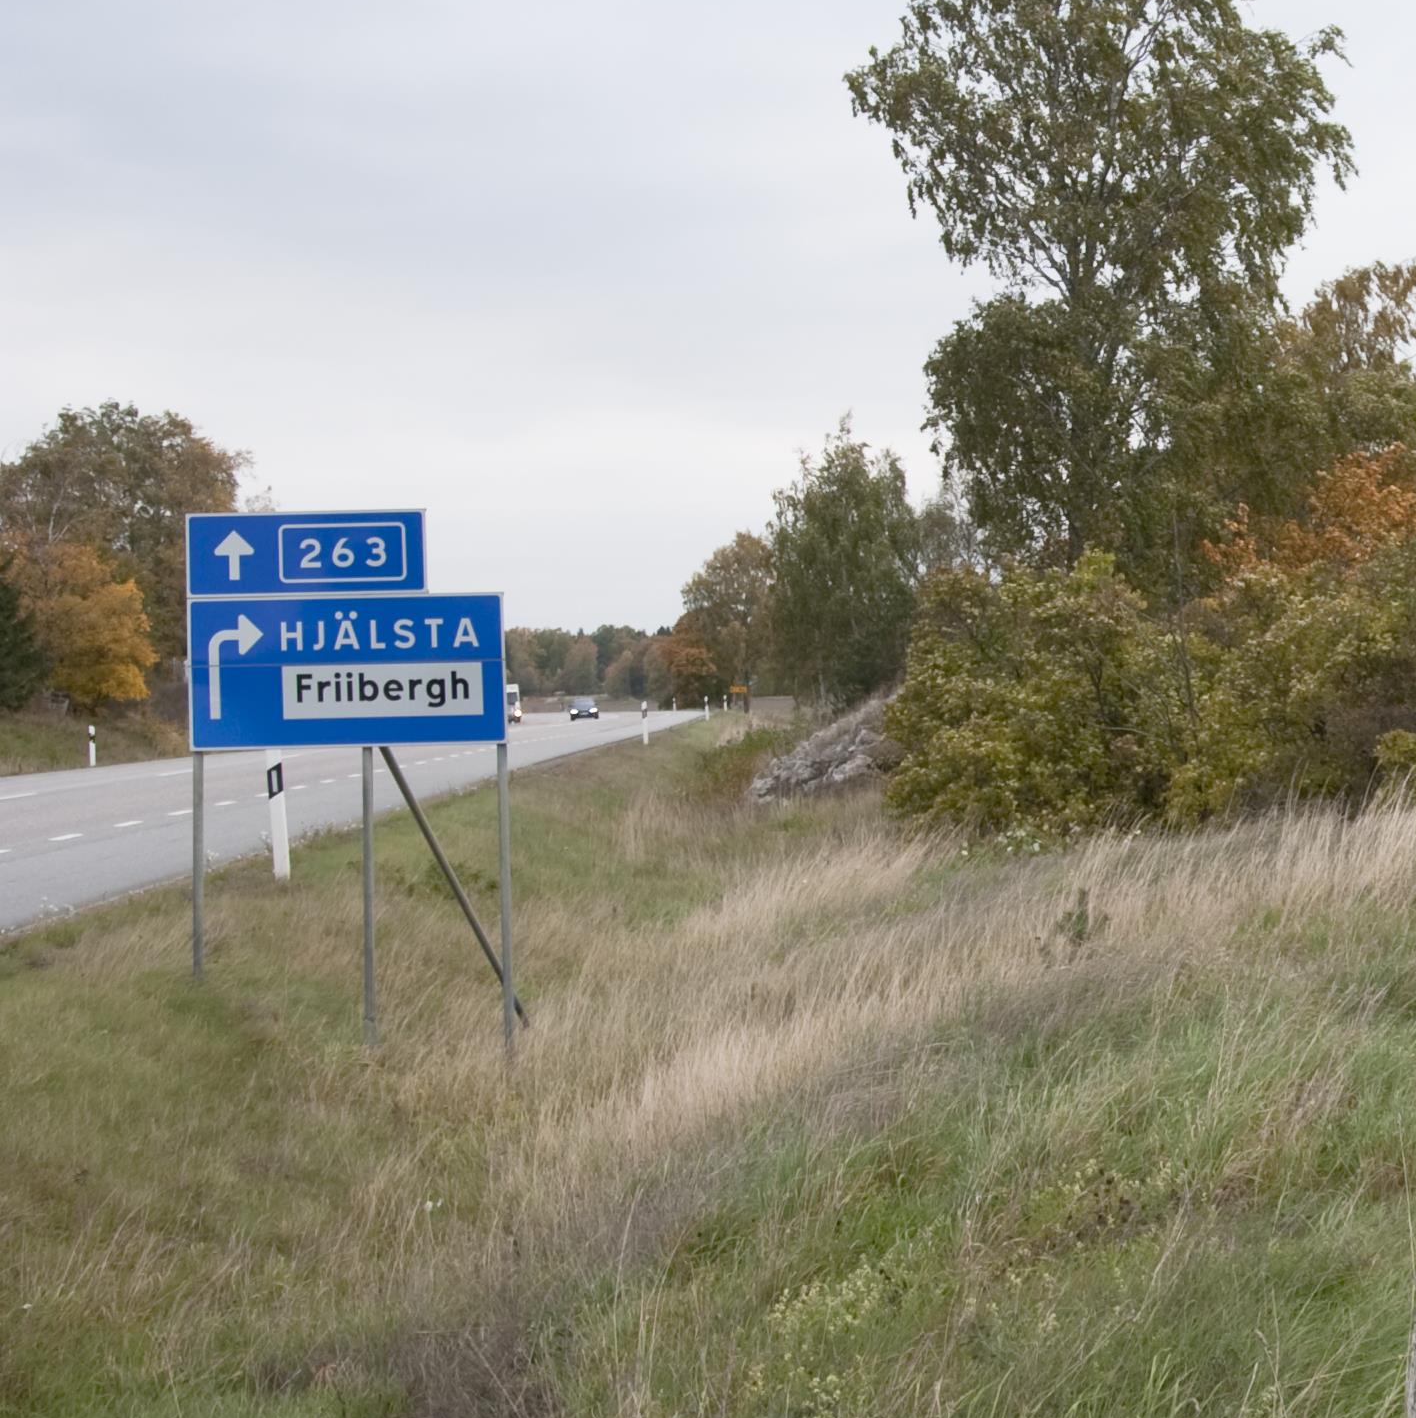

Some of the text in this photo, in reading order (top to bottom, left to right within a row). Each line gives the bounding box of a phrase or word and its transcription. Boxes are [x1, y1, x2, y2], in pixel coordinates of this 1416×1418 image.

[299, 536, 387, 568] 263
[280, 611, 480, 651] HJÄLSTA
[295, 671, 470, 708] Friibergh
